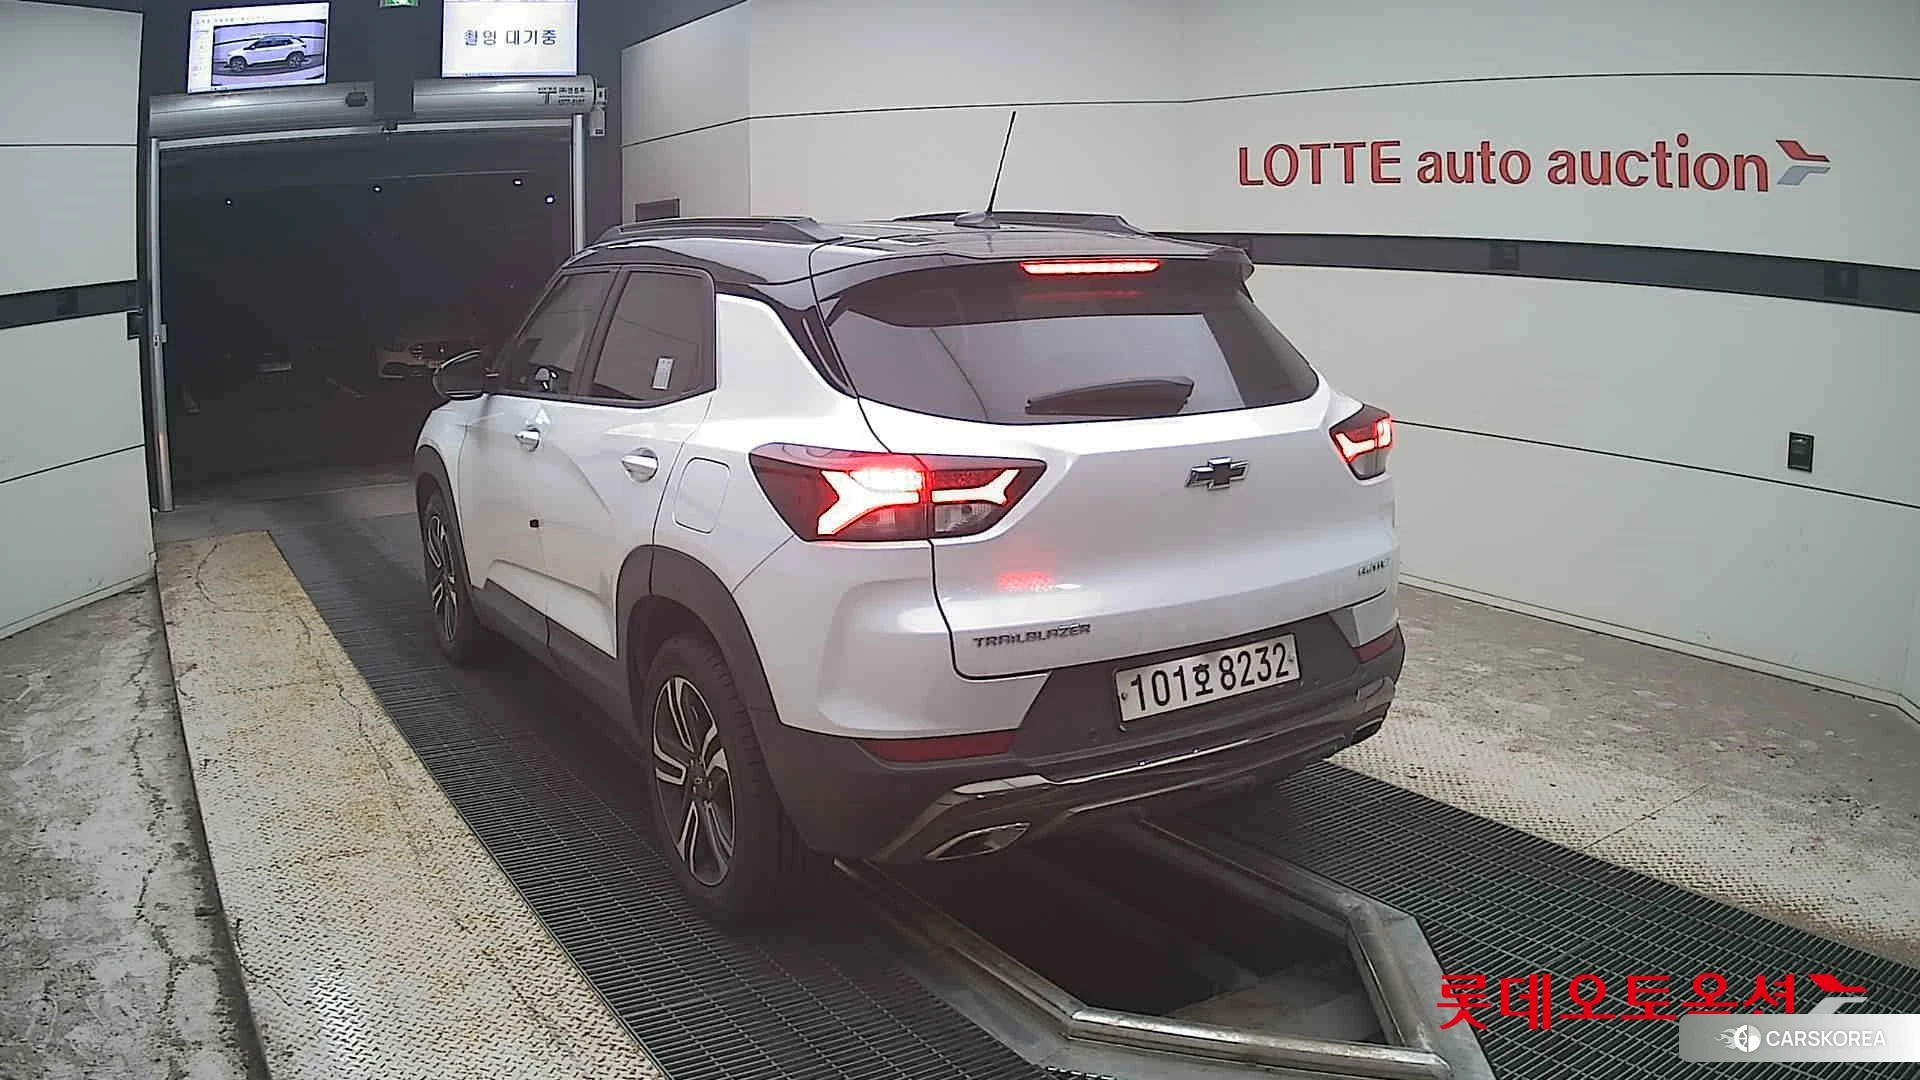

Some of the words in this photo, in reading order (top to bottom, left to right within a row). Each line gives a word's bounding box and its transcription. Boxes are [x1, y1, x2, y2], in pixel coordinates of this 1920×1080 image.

[505, 30, 557, 46] 대기중
[1239, 140, 1401, 187] LOTTE
[1417, 141, 1531, 184] auto
[1548, 133, 1769, 192] auction
[972, 624, 1090, 648] TRAILBLAZER
